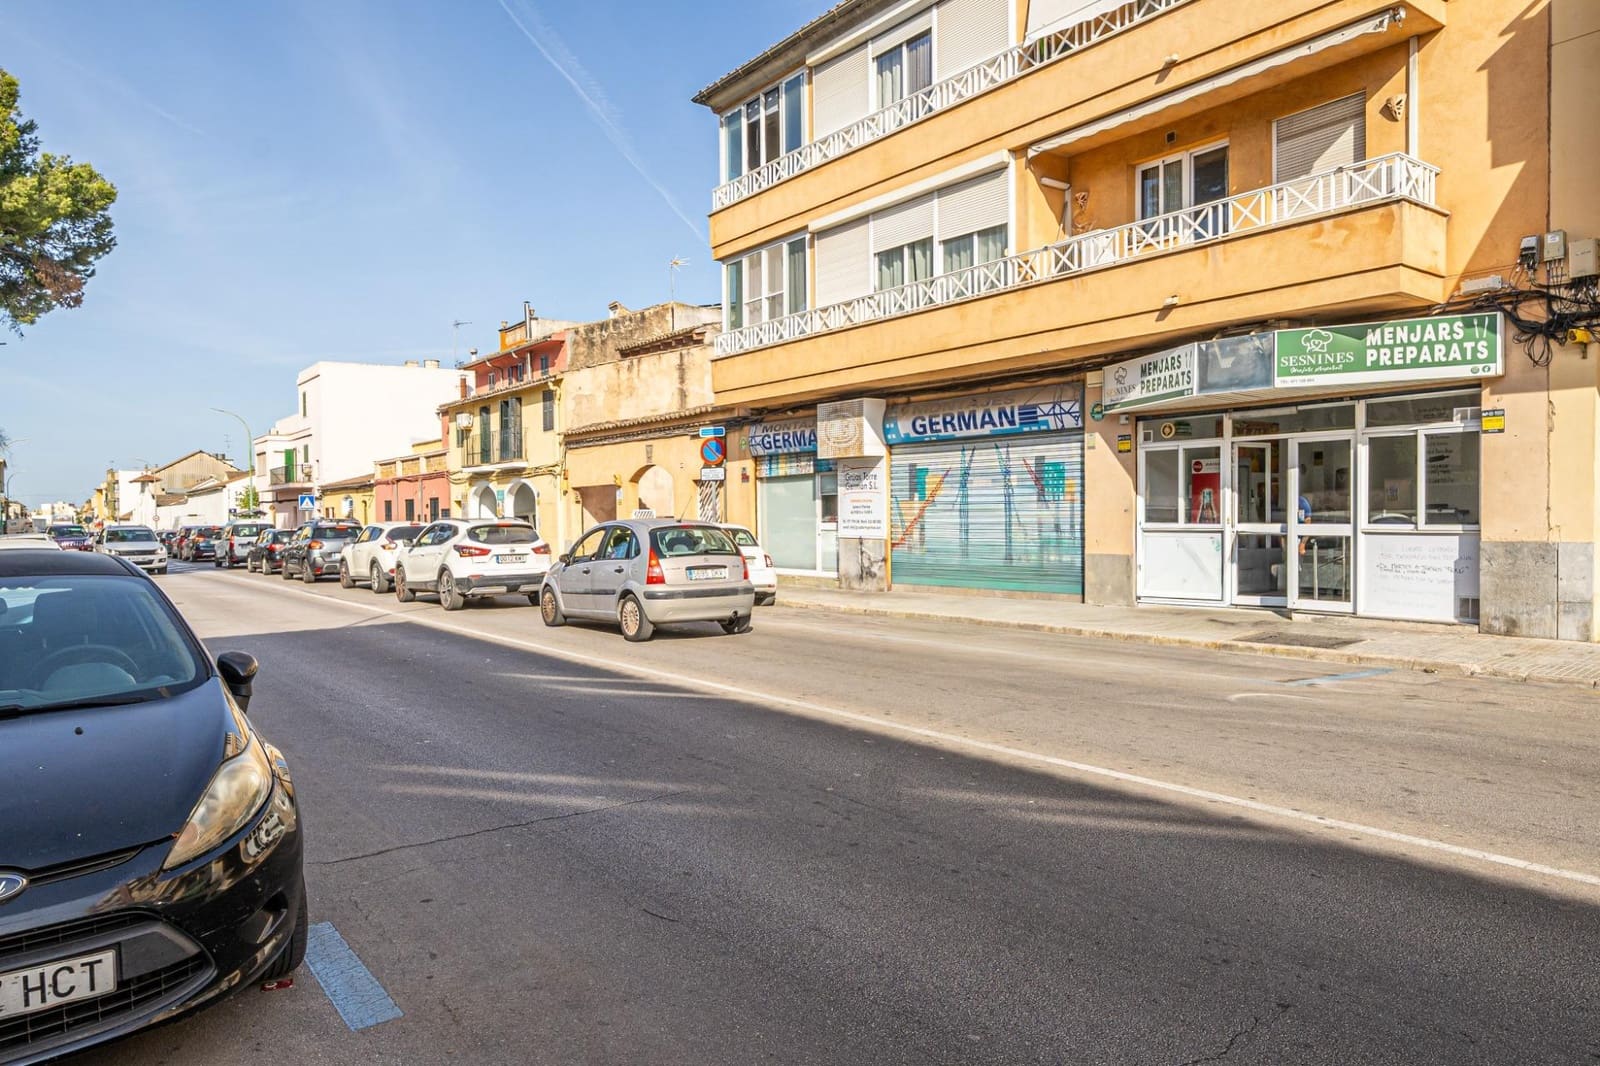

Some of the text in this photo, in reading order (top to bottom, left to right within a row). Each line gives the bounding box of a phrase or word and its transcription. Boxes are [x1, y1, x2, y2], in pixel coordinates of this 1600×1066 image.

[1366, 321, 1464, 346] MENJARS
[1140, 354, 1182, 378] MENJARS
[1280, 351, 1354, 367] SESNINES
[1366, 341, 1489, 367] PREPARATS
[1140, 370, 1192, 395] PREPARATS
[762, 423, 815, 434] MONTAJ
[911, 405, 1017, 436] GERMAN
[761, 428, 817, 450] GERMA
[22, 958, 103, 1008] HCT
